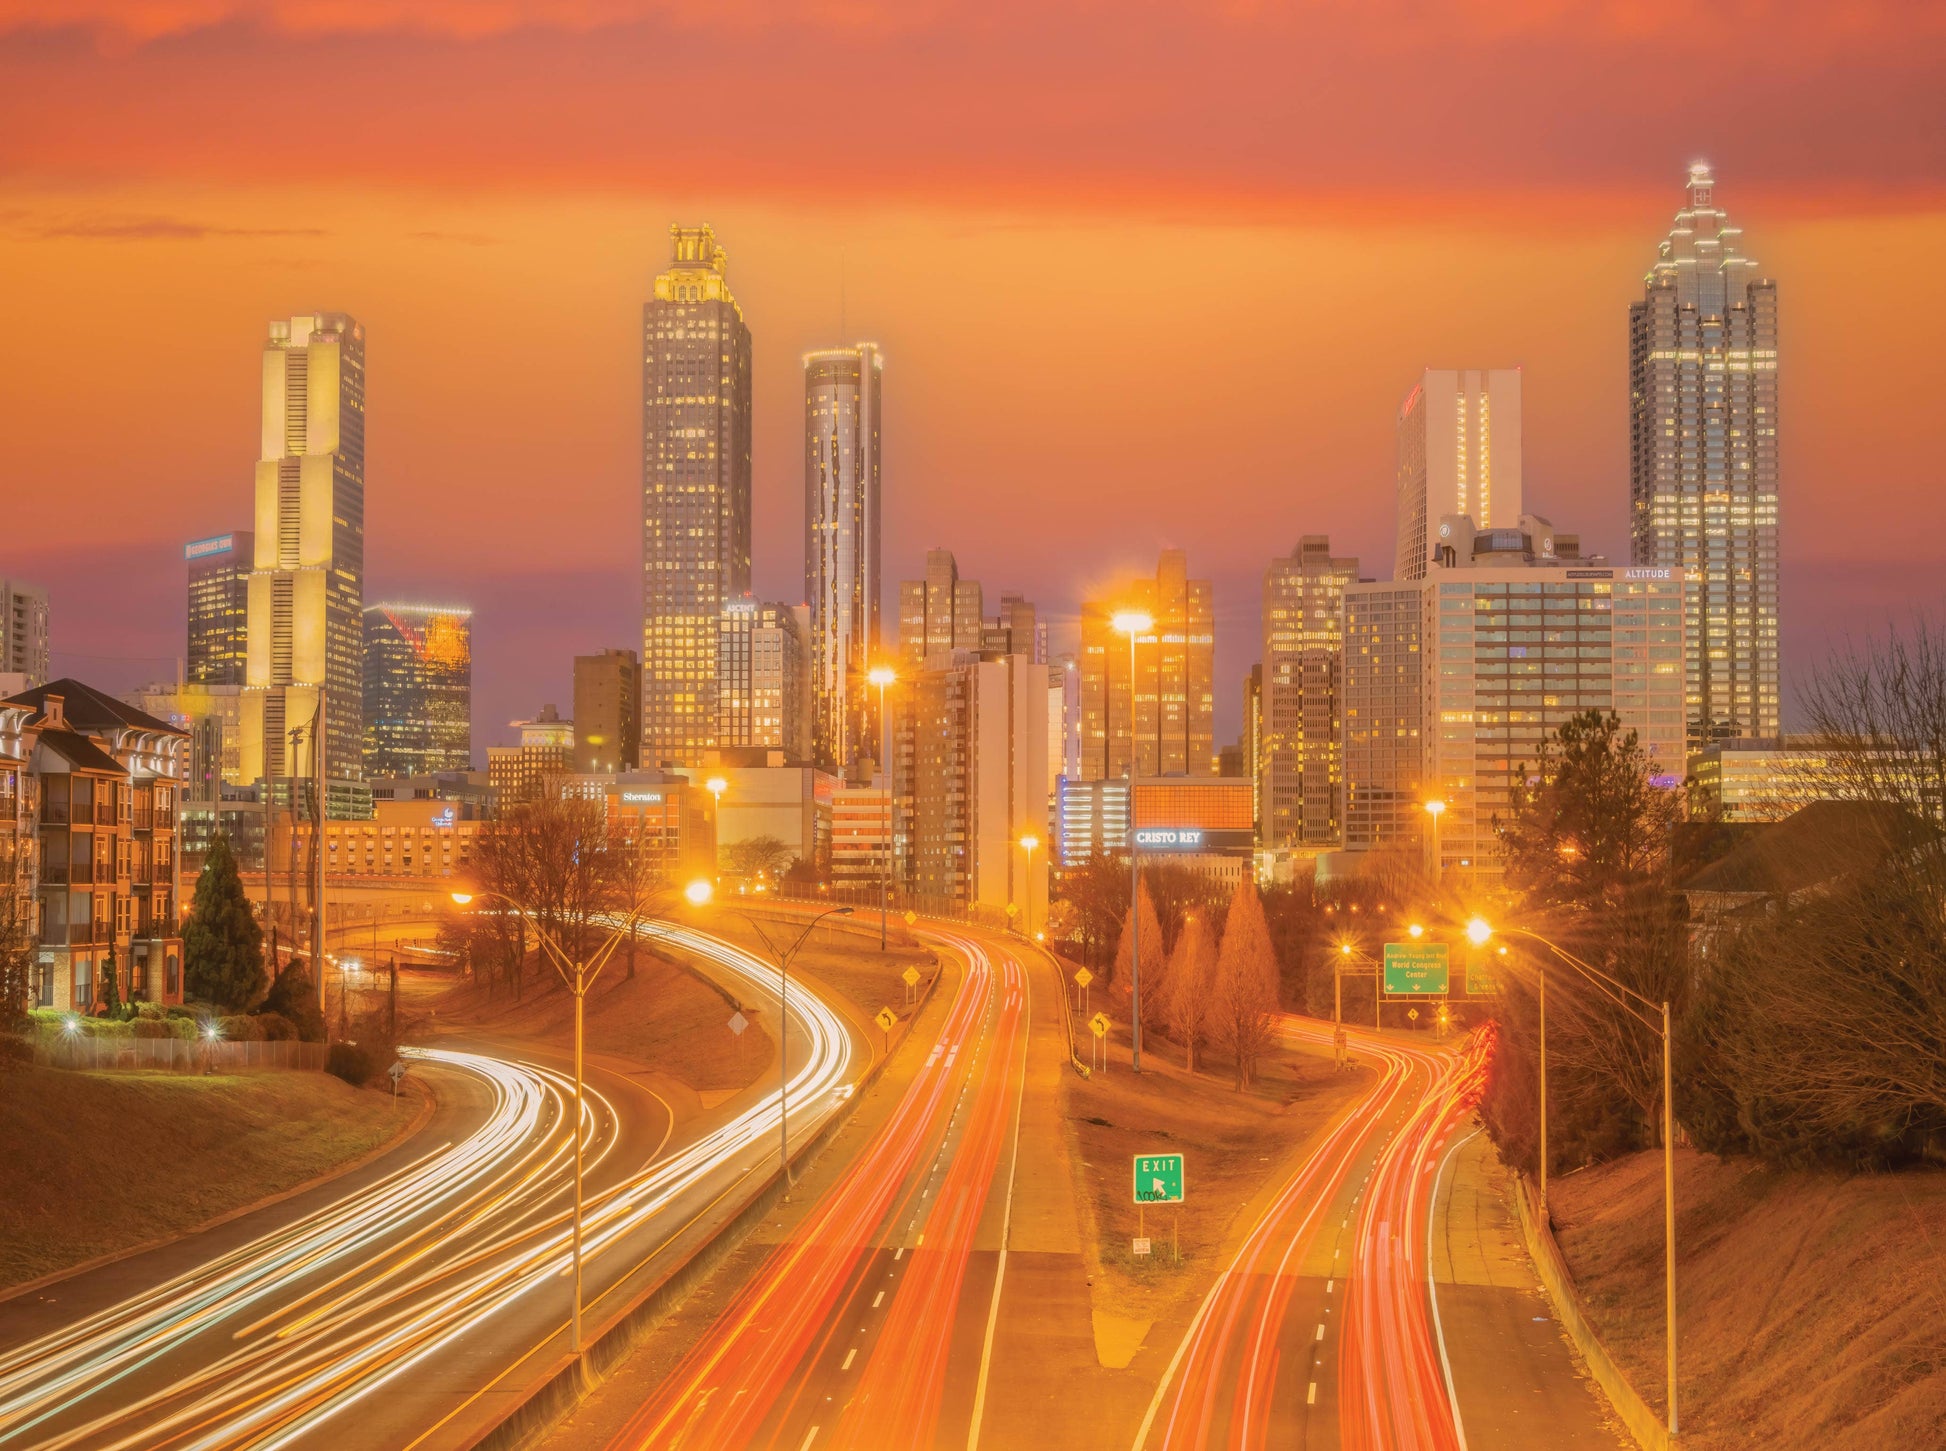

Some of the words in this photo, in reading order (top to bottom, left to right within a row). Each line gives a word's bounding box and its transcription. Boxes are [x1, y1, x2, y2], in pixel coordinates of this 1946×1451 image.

[1625, 569, 1671, 578] ALTITUDE
[623, 792, 661, 801] Sheraton
[1136, 832, 1176, 843] CRISTO
[1179, 832, 1200, 843] REY
[1392, 961, 1410, 969] World
[1411, 961, 1441, 969] Congress
[1142, 1159, 1175, 1172] EXIT
